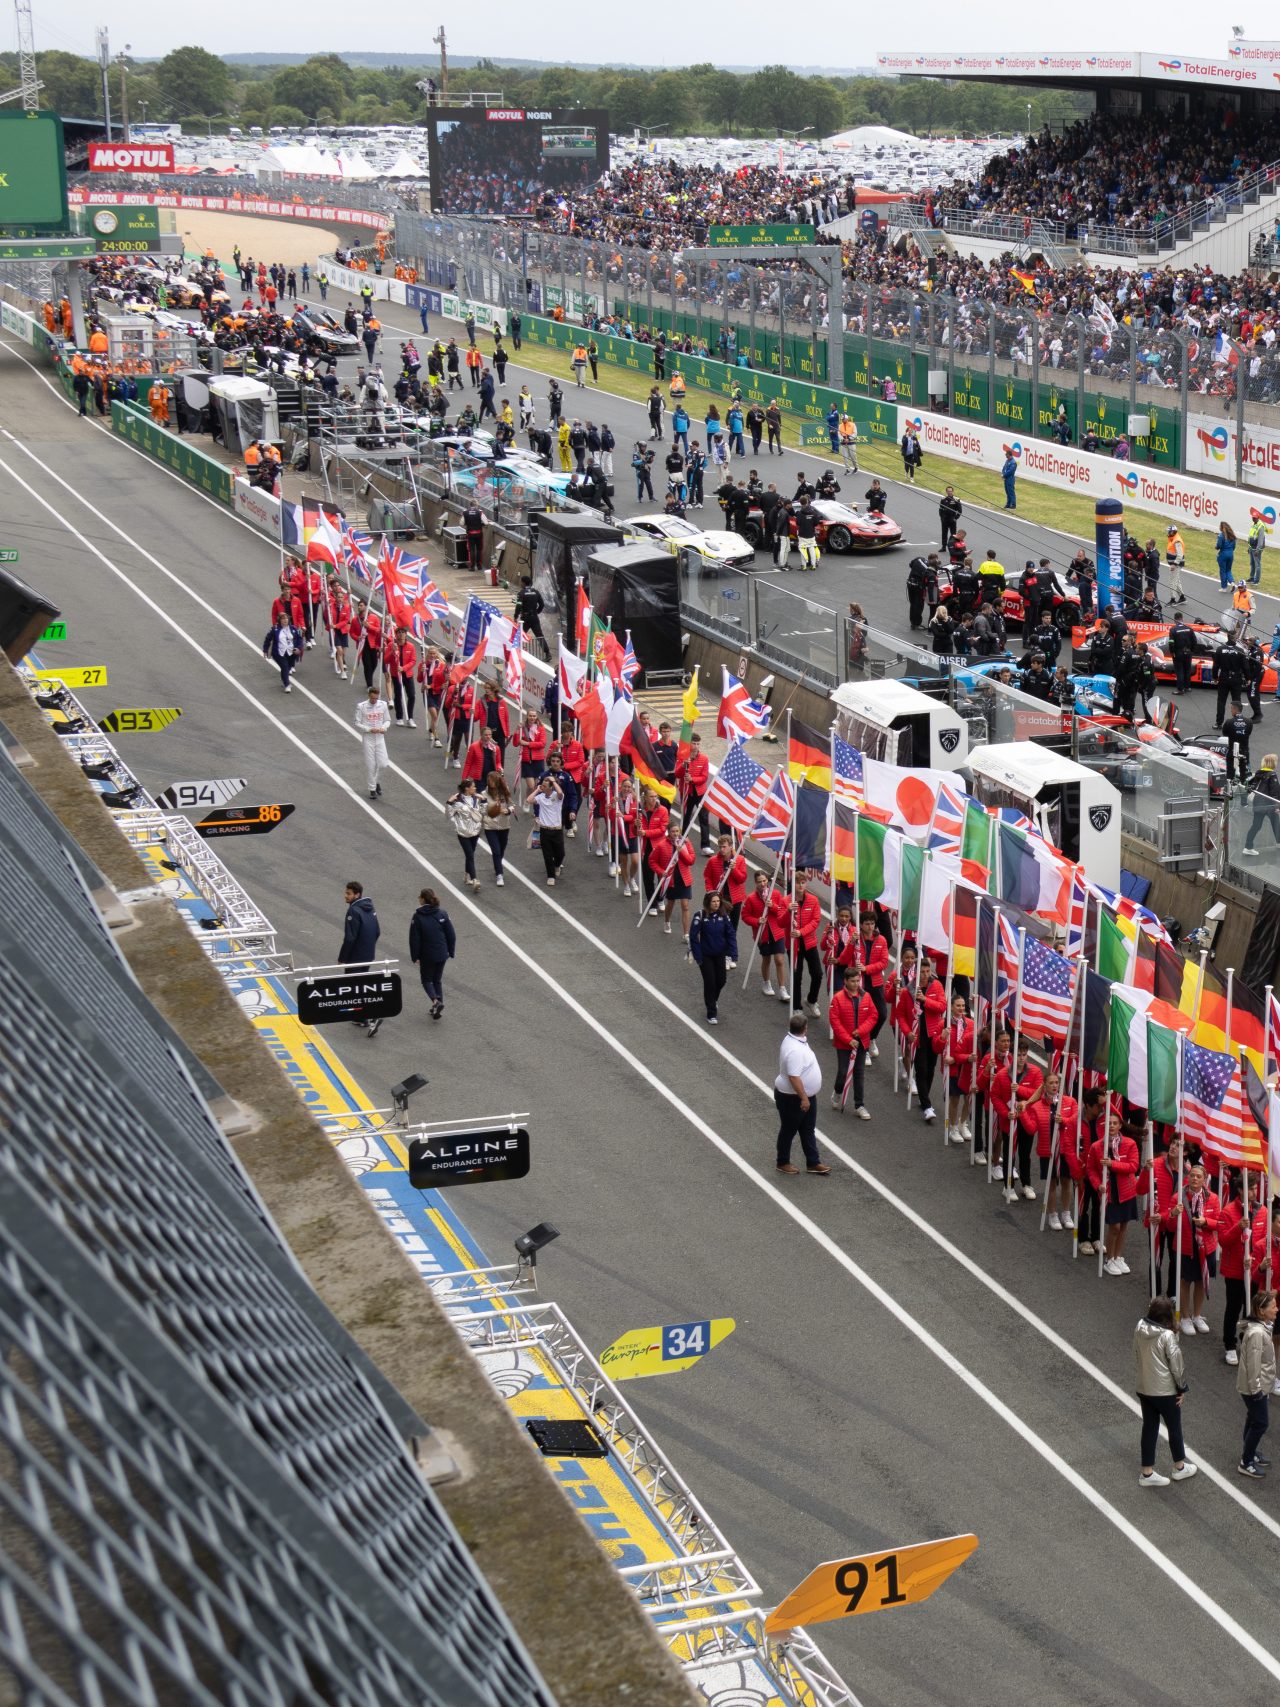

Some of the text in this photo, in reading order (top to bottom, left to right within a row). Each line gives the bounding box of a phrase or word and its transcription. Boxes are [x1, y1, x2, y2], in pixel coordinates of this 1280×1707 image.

[960, 58, 992, 68] TotalEnergies
[1003, 58, 1036, 69] TotalEnergies
[1048, 58, 1082, 70] TotalEnergies
[1096, 58, 1132, 70] TotalEnergies
[1184, 62, 1257, 81] TotalEnergies
[488, 112, 552, 120] MOTUL NGEN
[94, 150, 170, 167] MOTUL
[68, 192, 83, 203] TUL
[90, 194, 118, 204] MOTUL
[102, 242, 148, 251] 24:00:00
[801, 359, 822, 375] ROLX
[894, 380, 912, 396] OLEX
[955, 392, 981, 410] ROLEX
[996, 400, 1024, 420] ROLEX
[924, 422, 981, 454] TotalEnergies
[1086, 420, 1117, 440] ROLEX
[1024, 448, 1090, 484] TotalEnergies
[1140, 477, 1218, 518] TotalEnergies
[1108, 530, 1122, 580] POSITION
[82, 670, 101, 684] 27
[120, 712, 152, 730] 93
[1028, 714, 1072, 727] databricks
[179, 784, 215, 806] 94
[258, 805, 281, 822] 86
[219, 826, 250, 834] RACING
[308, 982, 392, 998] ALPINE
[318, 1000, 362, 1008] ENDURANCE
[420, 1139, 518, 1160] ALPINE
[432, 1156, 507, 1170] ENDURANCE TEAM
[668, 1325, 704, 1356] 34
[601, 1345, 651, 1366] Europol
[834, 1554, 906, 1612] 91
